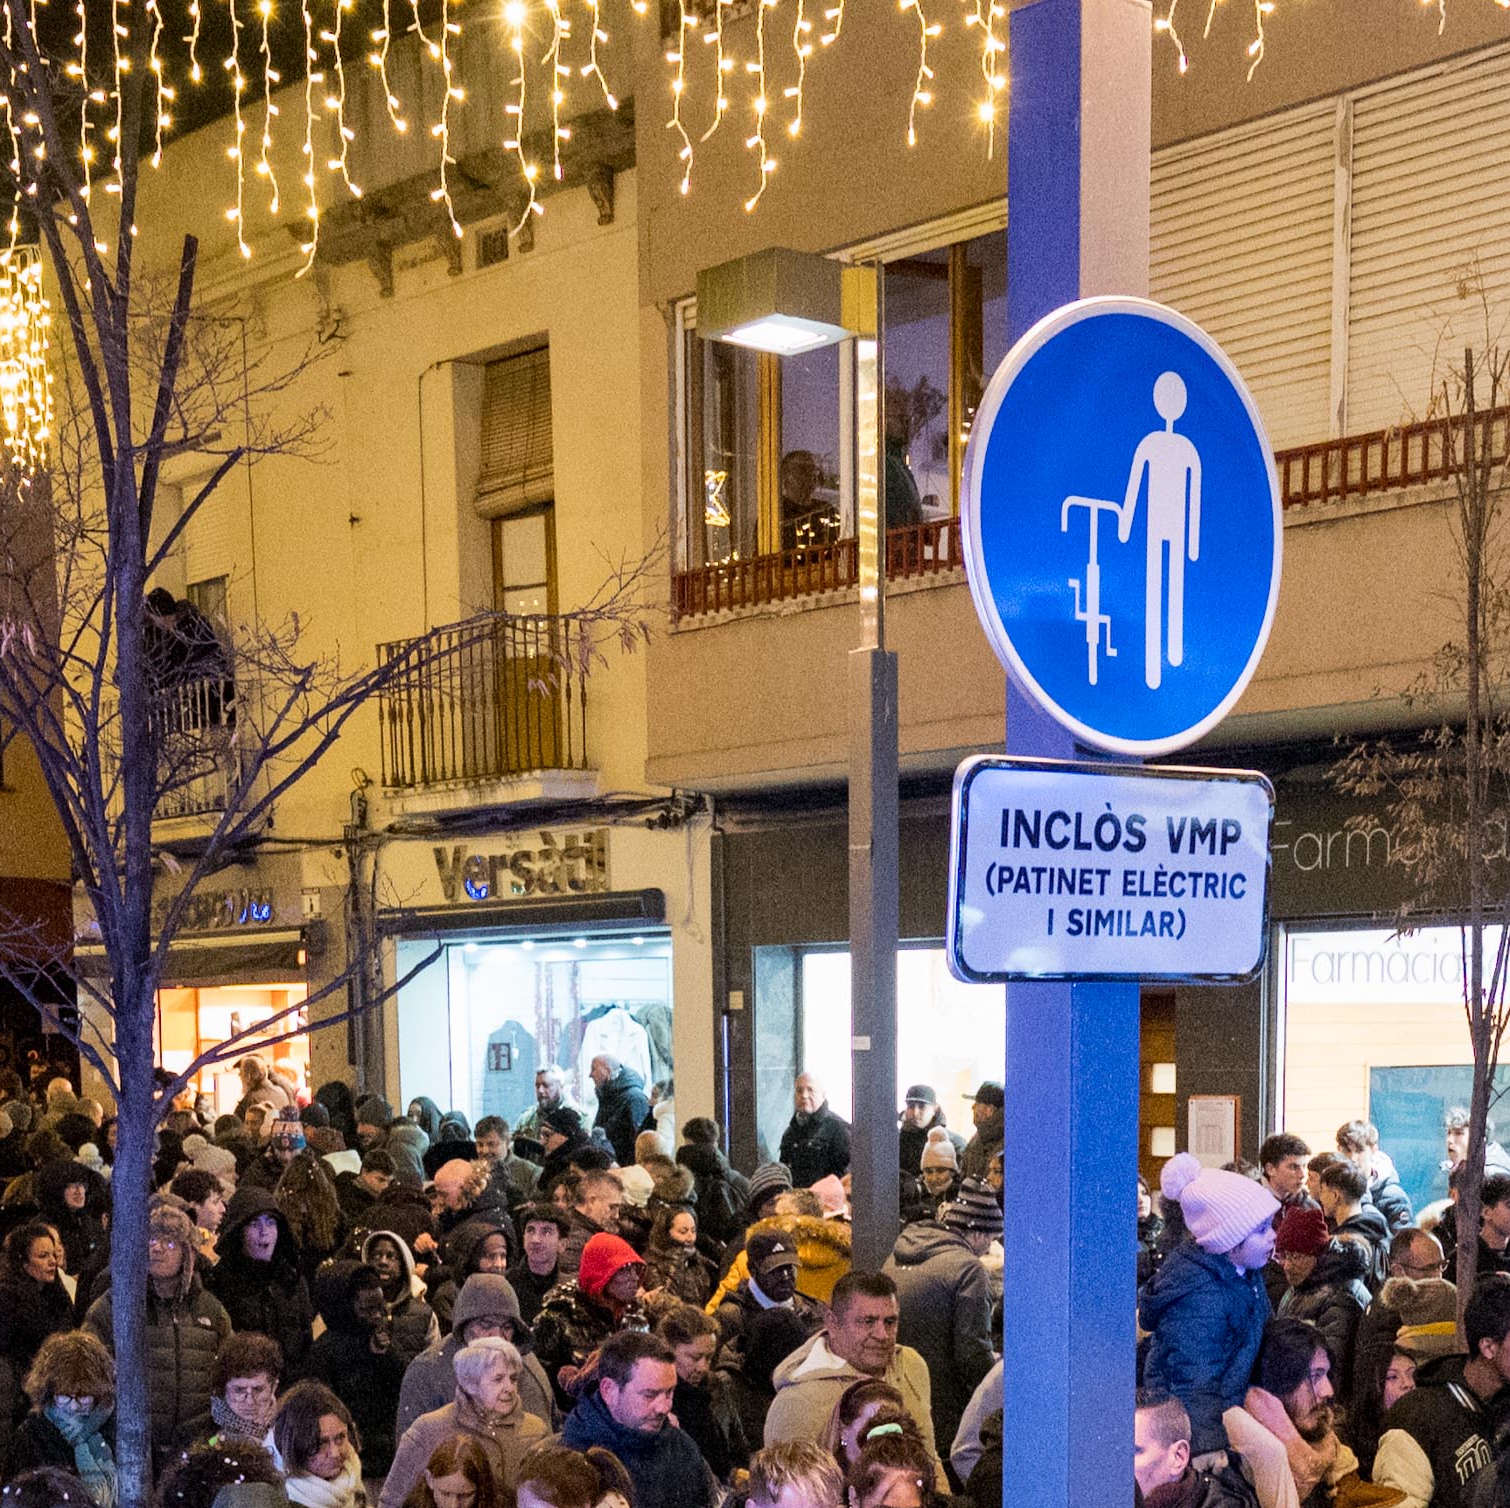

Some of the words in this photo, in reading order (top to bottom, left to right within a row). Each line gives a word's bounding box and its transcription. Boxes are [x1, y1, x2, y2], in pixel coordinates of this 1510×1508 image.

[999, 801, 1147, 853] INCLÒS
[1166, 815, 1242, 856] VMP
[986, 861, 1111, 897] (PATINET
[1122, 863, 1247, 899] ELÈCTRIC
[1046, 909, 1054, 936] I
[1067, 907, 1187, 941] SIMILAR)
